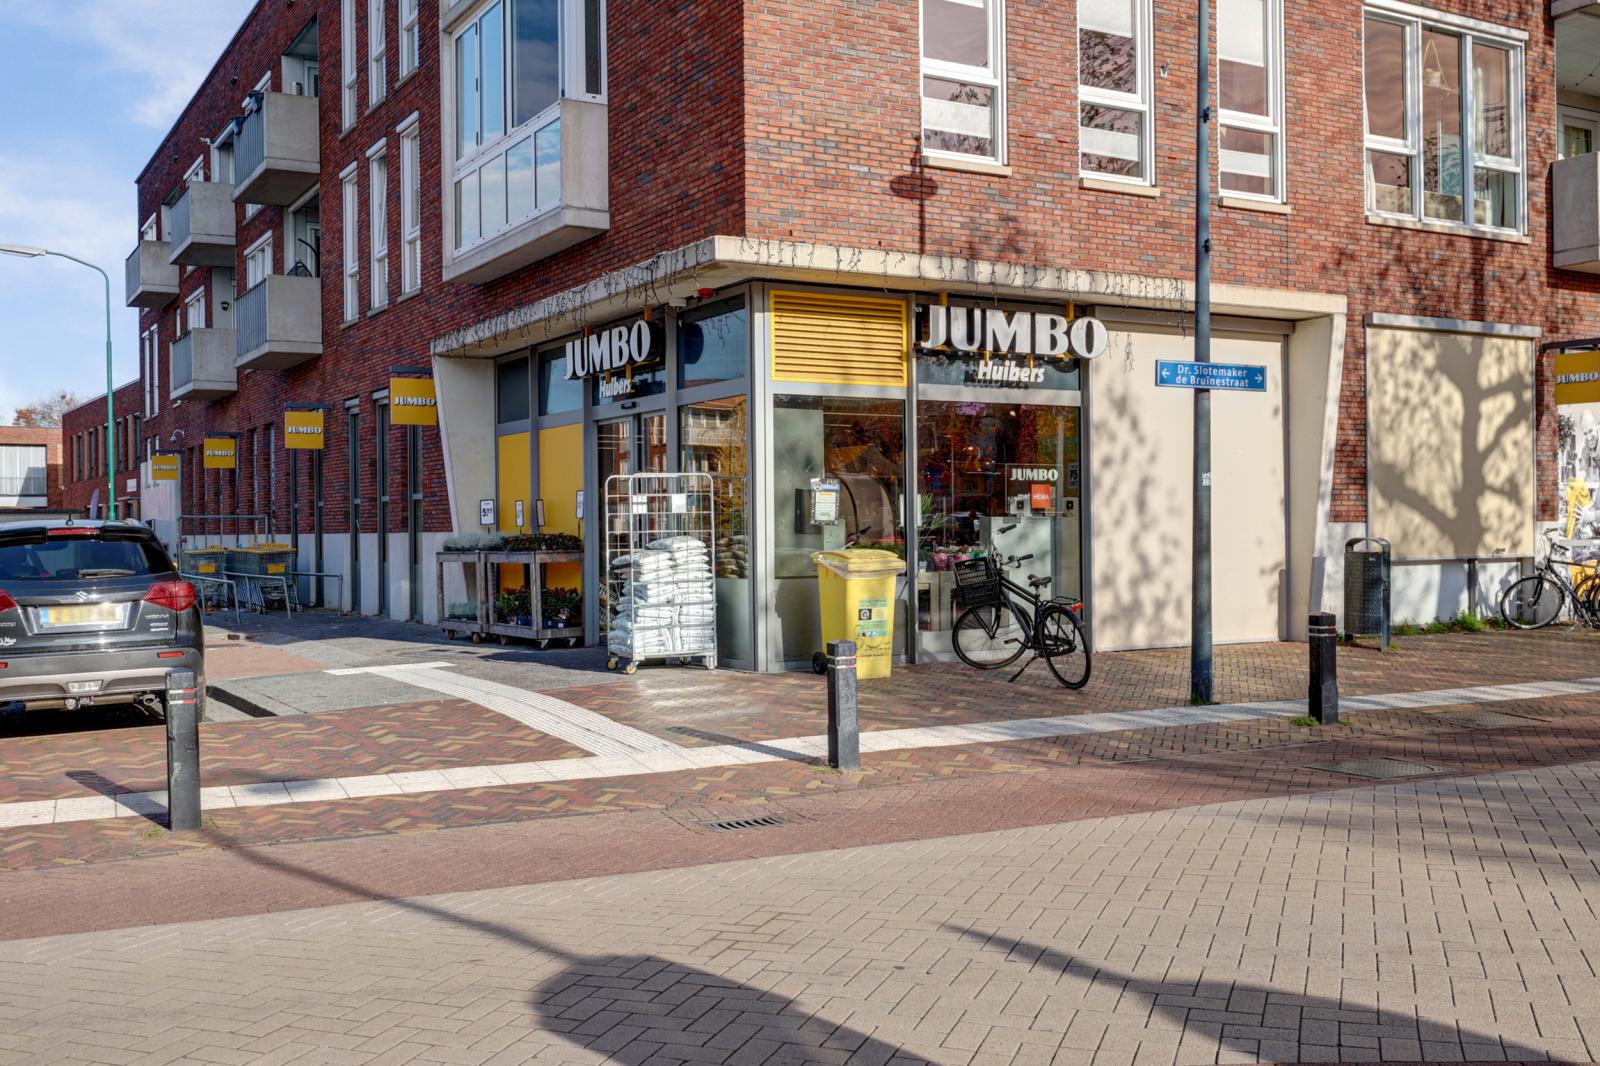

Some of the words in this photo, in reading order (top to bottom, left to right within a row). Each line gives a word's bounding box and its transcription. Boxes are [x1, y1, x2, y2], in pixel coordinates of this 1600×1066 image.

[920, 304, 1108, 359] JUMBO
[564, 319, 651, 381] JUMBO
[978, 359, 1045, 383] Huibers
[1177, 364, 1191, 375] Dr.
[1194, 365, 1247, 378] Slotemaker
[1556, 371, 1599, 384] JUMBO
[1176, 375, 1187, 384] de
[393, 396, 436, 407] JUMBO
[287, 425, 322, 435] JUMBO
[1010, 468, 1059, 481] JUMBO
